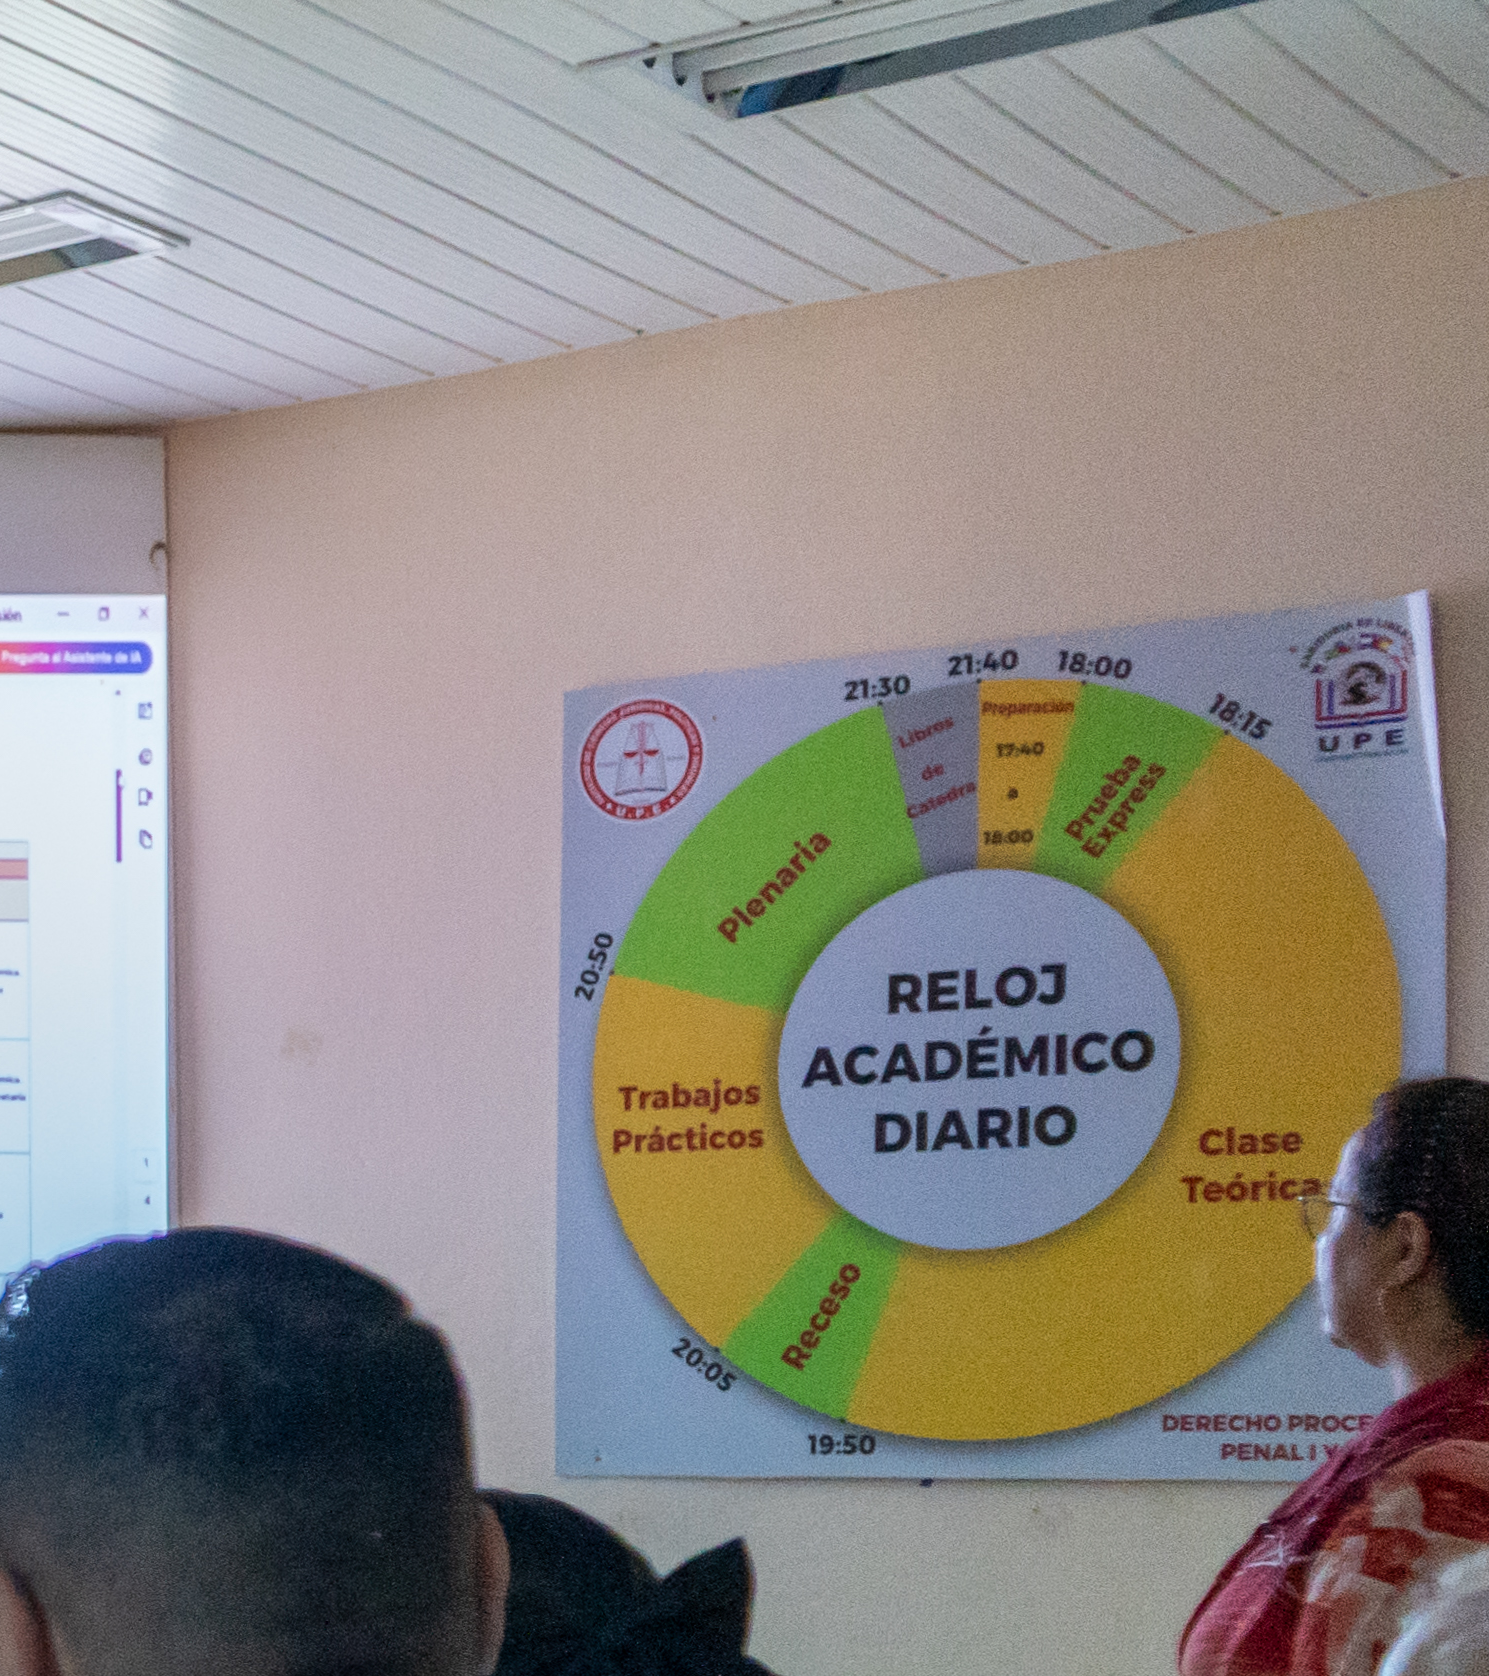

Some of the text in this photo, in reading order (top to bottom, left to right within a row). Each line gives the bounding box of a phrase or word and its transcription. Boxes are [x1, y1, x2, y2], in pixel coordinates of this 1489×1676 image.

[948, 650, 1019, 676] 21:40
[1058, 650, 1132, 679] 18:00
[844, 675, 911, 701] 21:30
[1208, 691, 1273, 743] 18:15
[899, 718, 954, 749] Libros
[1318, 729, 1404, 752] UPE
[996, 742, 1045, 758] 17:40
[921, 764, 944, 782] de
[1064, 755, 1141, 840] Prueba
[1082, 763, 1166, 858] Express
[984, 829, 1034, 845] 18:00
[715, 827, 833, 945] Plenaria
[575, 930, 614, 1003] 20:50
[886, 963, 1068, 1016] RELOJ
[801, 1026, 1155, 1089] ACADÉMICO
[617, 1079, 762, 1117] Trabajos
[613, 1123, 764, 1155] Prácticos
[873, 1104, 1078, 1154] DIARIO
[1199, 1126, 1302, 1157] Clase
[1181, 1171, 1323, 1205] Teórica
[781, 1261, 862, 1373] Receso
[671, 1337, 737, 1394] 20:05
[1162, 1414, 1374, 1432] DERECHO PROCE
[807, 1432, 876, 1457] 19:50
[1221, 1443, 1304, 1461] PENAL
